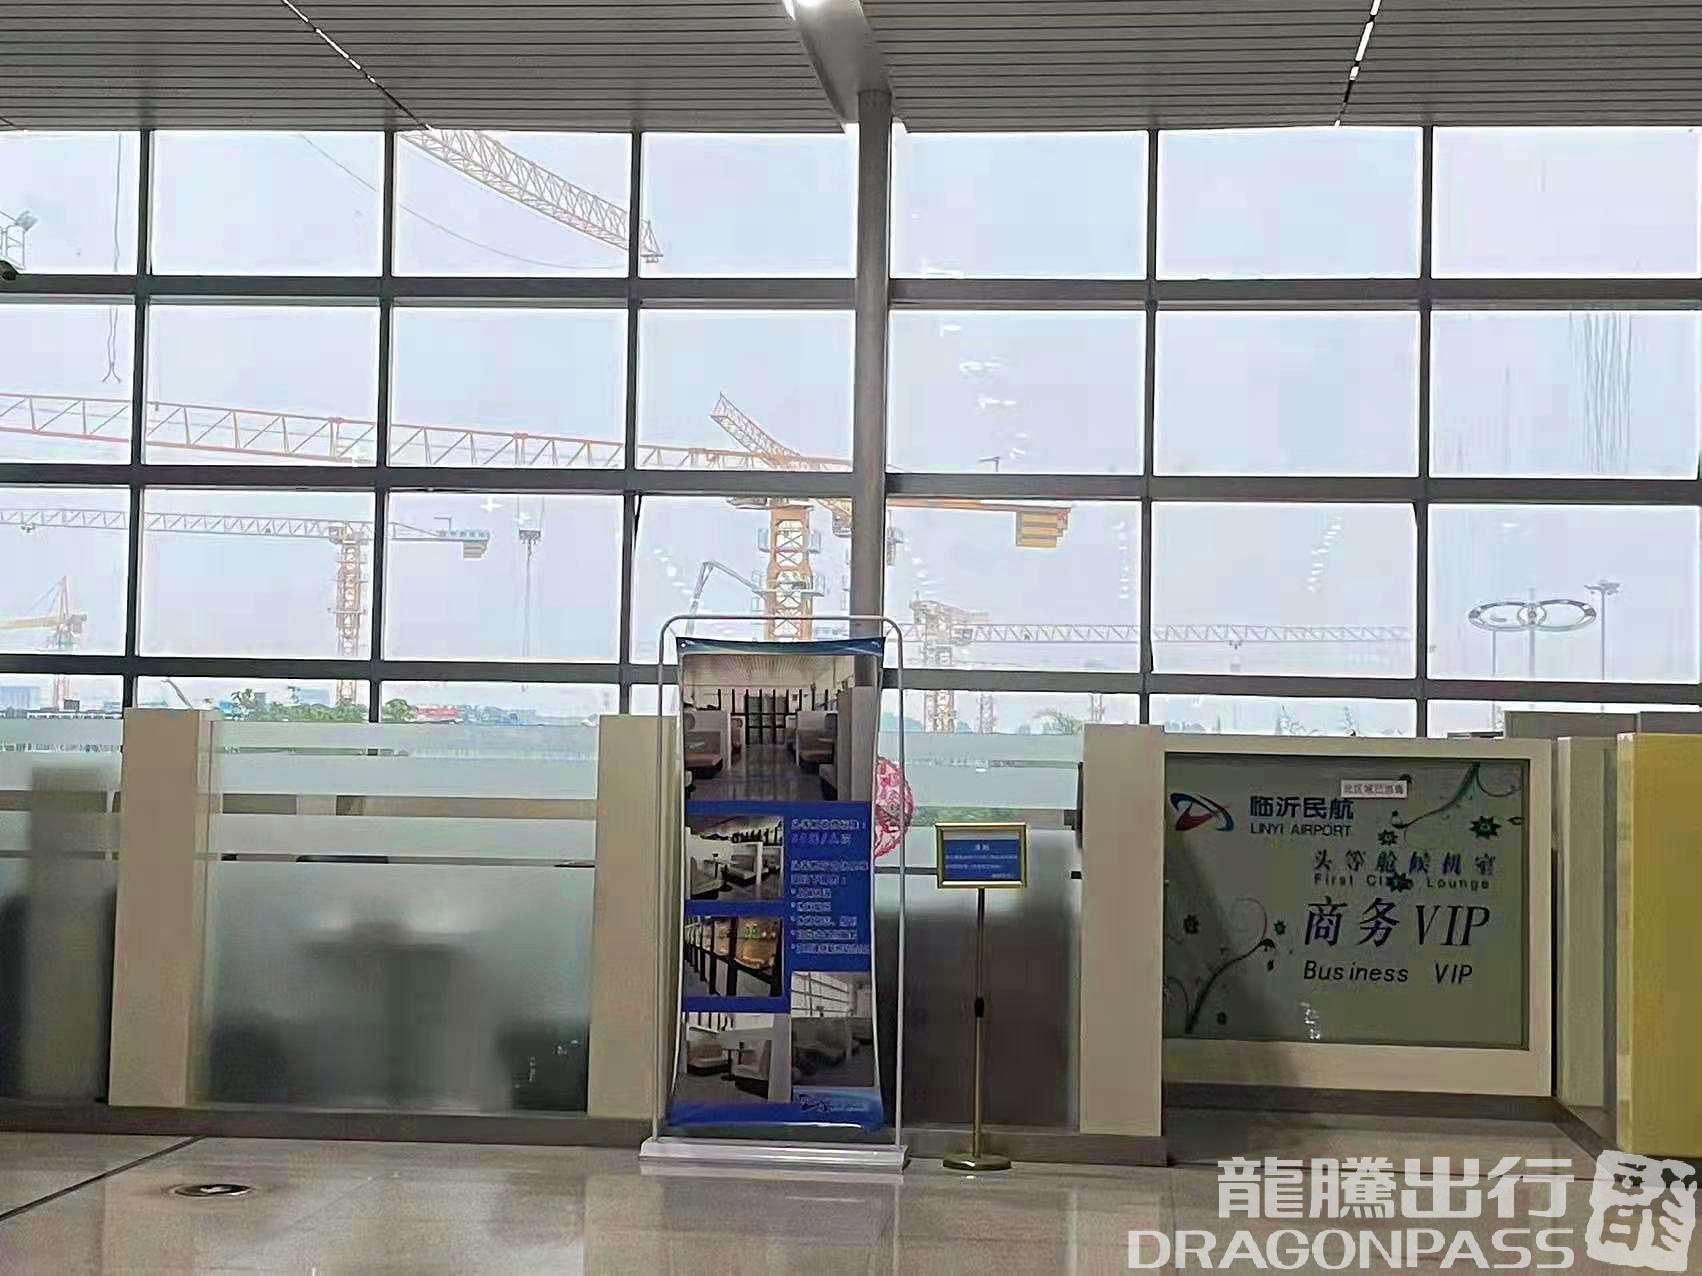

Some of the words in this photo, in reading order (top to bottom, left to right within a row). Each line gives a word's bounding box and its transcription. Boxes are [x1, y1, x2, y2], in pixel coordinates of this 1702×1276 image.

[1250, 795, 1354, 819] 临沂民航
[1250, 823, 1284, 834] LINYI
[1291, 824, 1352, 837] AIRPORT
[1314, 849, 1496, 875] 头等舱候机室
[1314, 872, 1354, 887] First
[1427, 877, 1490, 891] Lounge
[1304, 896, 1400, 947] 商务
[1416, 904, 1490, 946] VIP
[1304, 960, 1408, 982] Business
[1435, 962, 1473, 984] VIP
